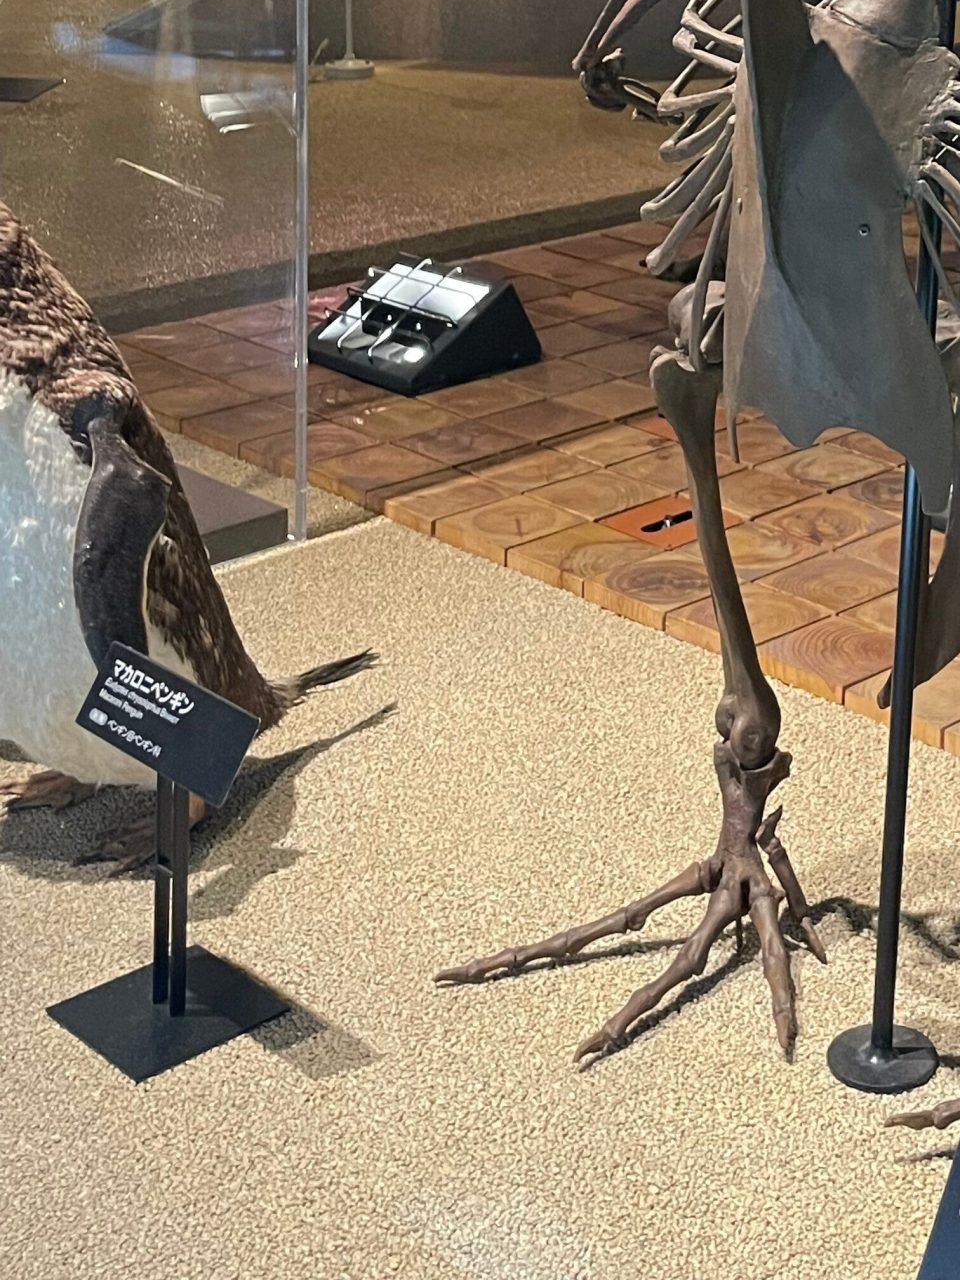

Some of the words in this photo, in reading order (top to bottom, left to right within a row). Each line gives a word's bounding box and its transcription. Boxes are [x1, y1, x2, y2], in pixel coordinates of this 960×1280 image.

[114, 658, 195, 715] マカロニペンギン
